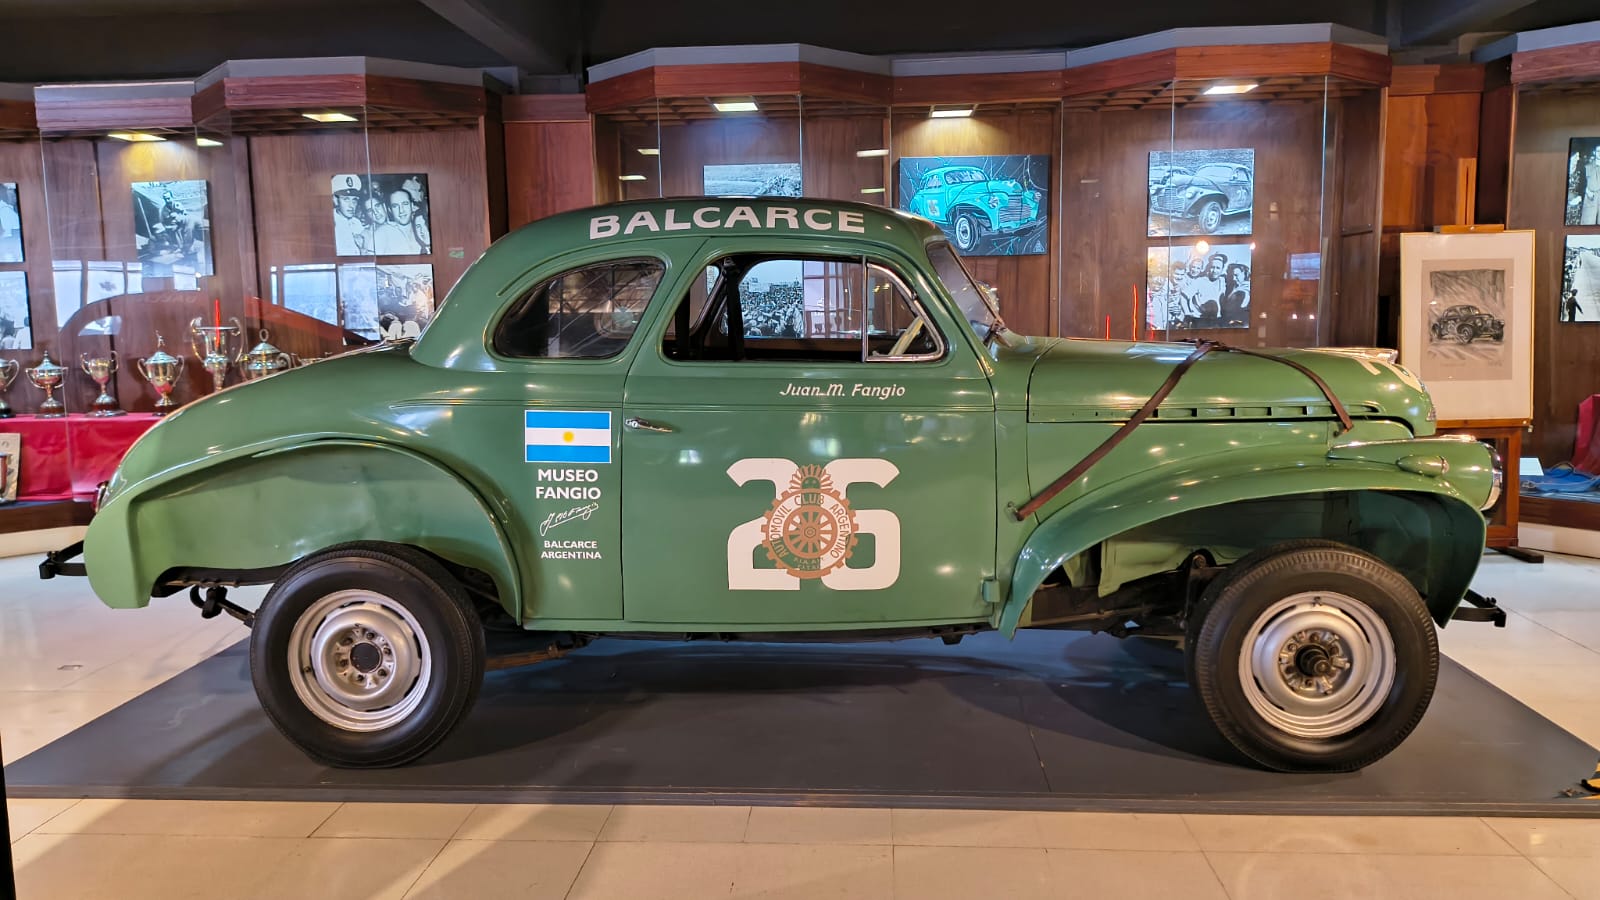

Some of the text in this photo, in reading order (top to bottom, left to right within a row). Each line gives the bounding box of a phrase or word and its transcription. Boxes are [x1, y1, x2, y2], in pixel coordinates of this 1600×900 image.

[589, 206, 865, 240] BALCARCE
[779, 383, 821, 396] Juan
[851, 383, 906, 400] Fangio
[537, 468, 599, 482] MUSEO
[535, 486, 602, 500] FANGIO
[726, 457, 901, 592] 26
[770, 493, 851, 559] AUTOMOVIL CLUB ARGENTINO
[543, 540, 598, 549] BALCARCE
[540, 551, 602, 560] ARGENTINA
